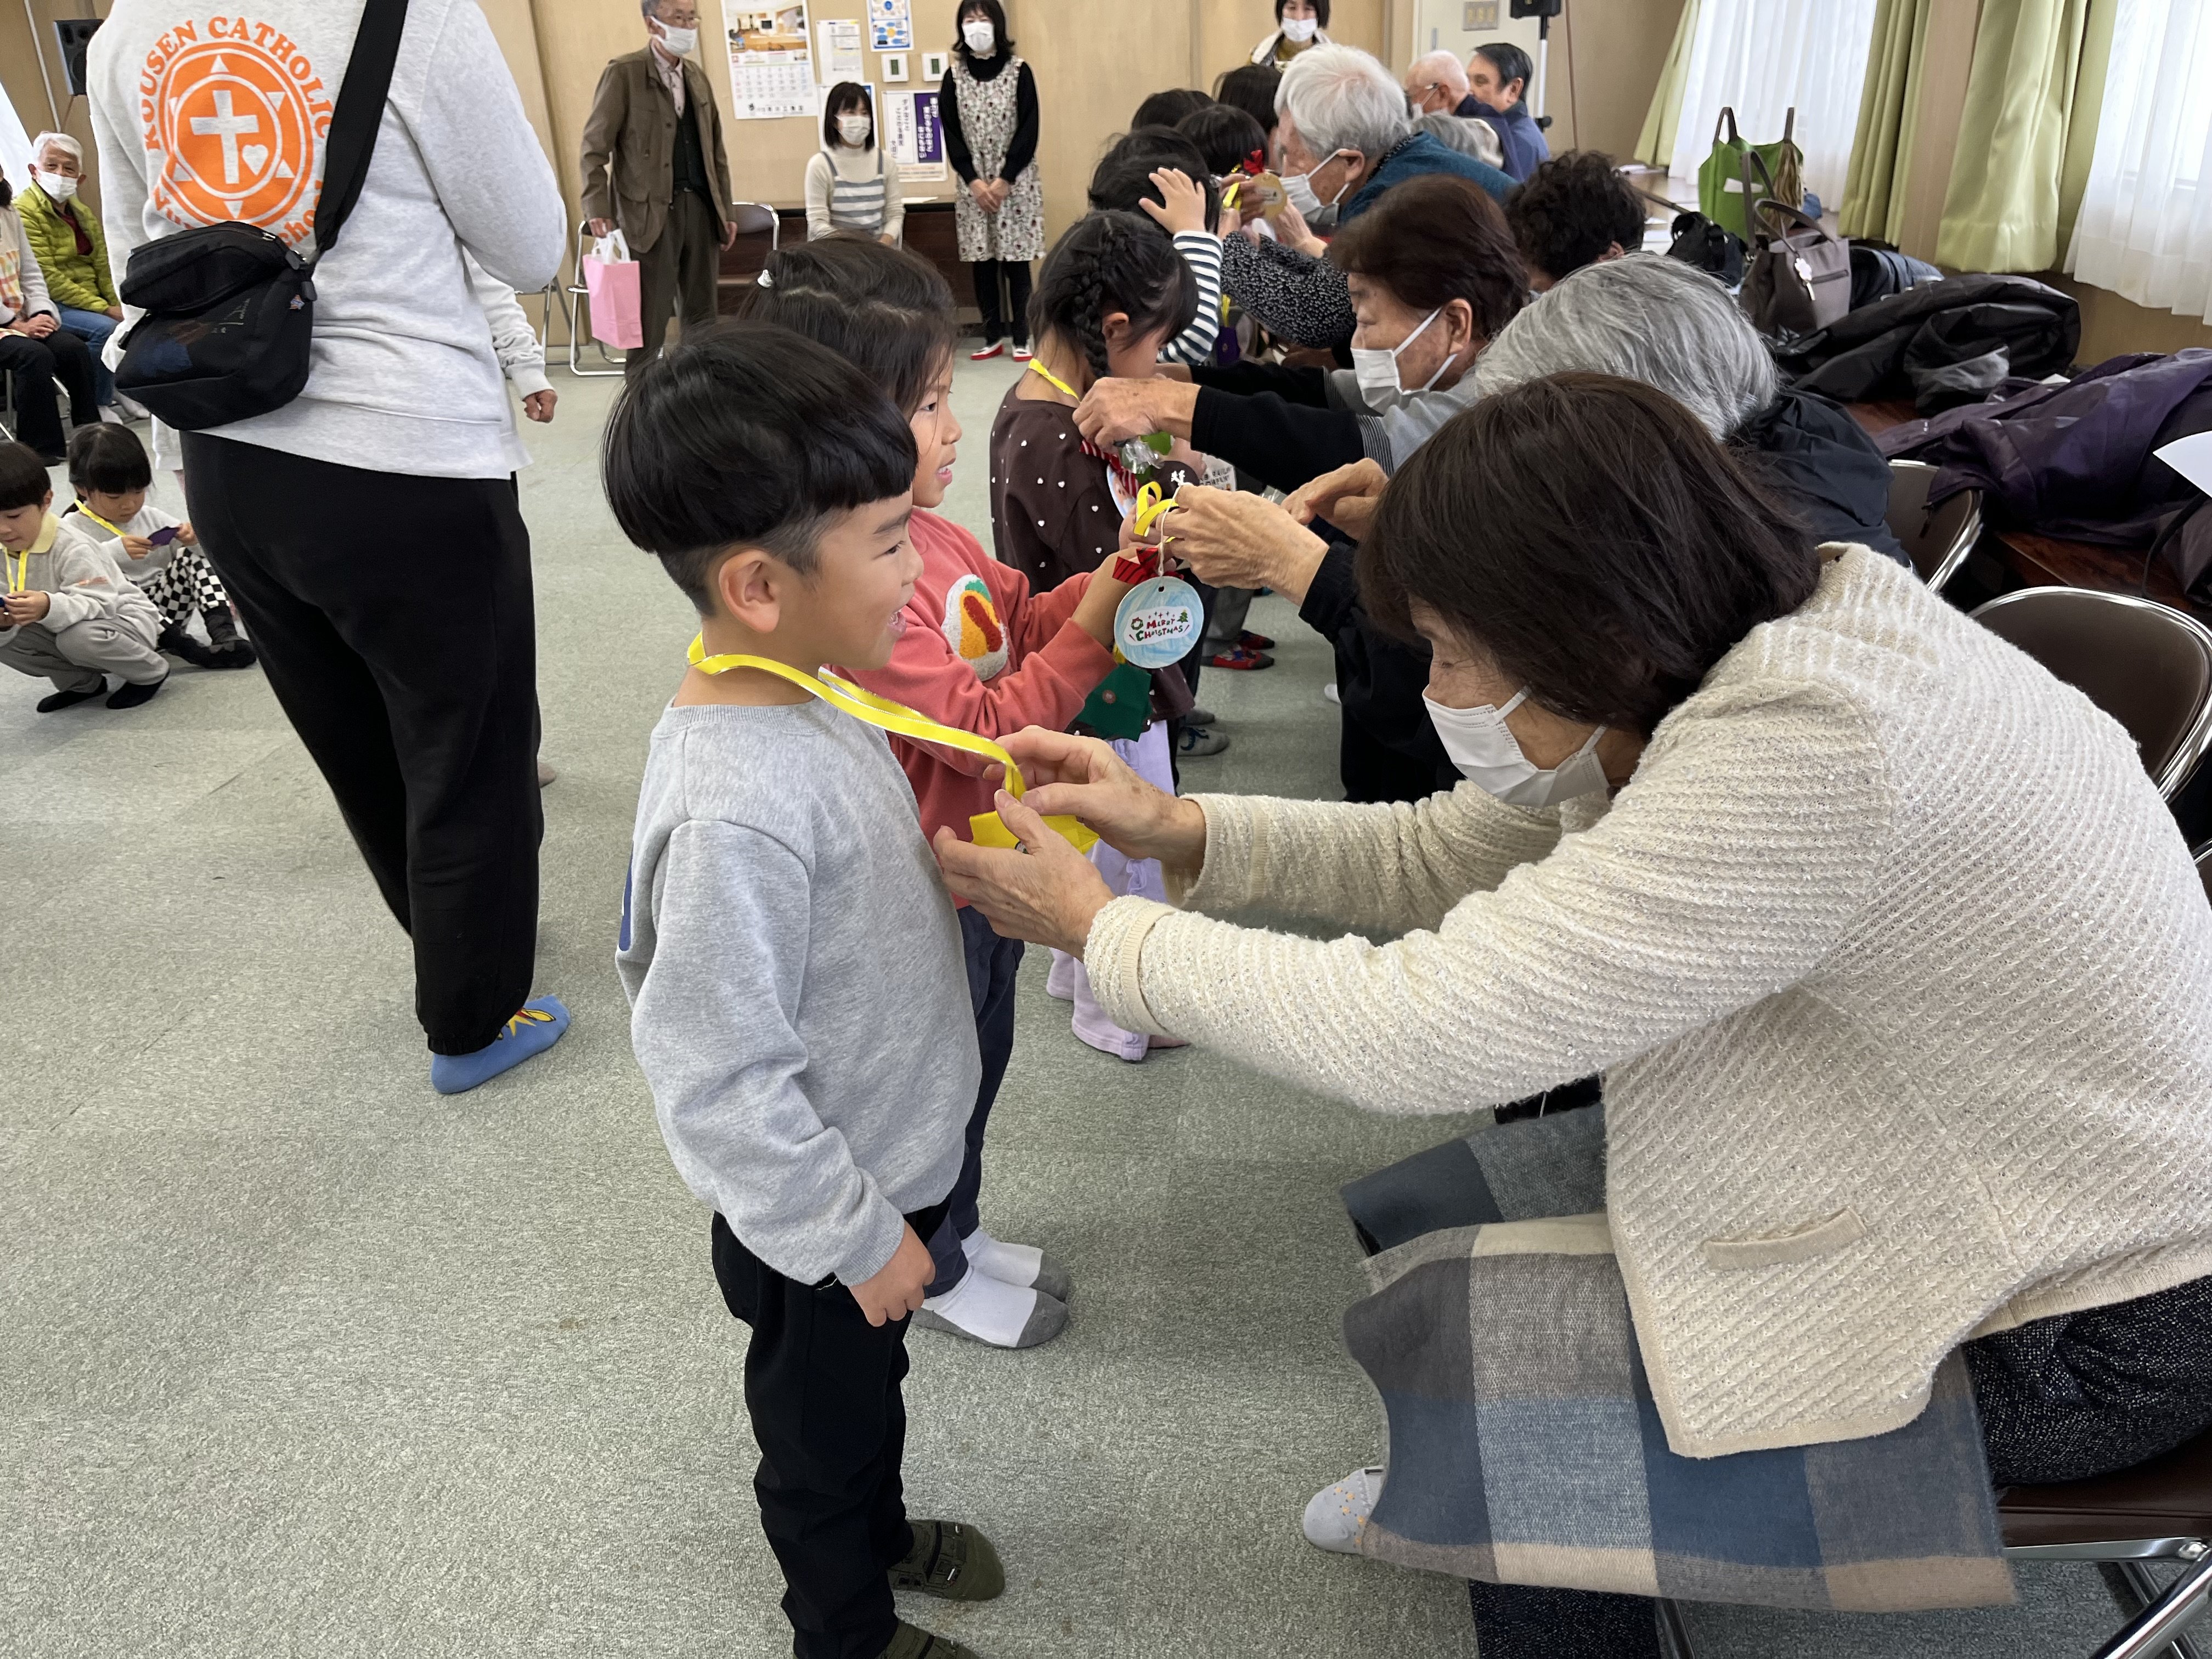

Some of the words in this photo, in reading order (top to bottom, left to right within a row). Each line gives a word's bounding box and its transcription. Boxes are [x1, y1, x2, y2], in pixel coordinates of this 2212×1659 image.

[139, 20, 198, 151] KOUSEN
[208, 16, 335, 139] CATHOLIC
[1147, 618, 1175, 629] MERRY
[1136, 625, 1183, 641] CHRISTMAS
